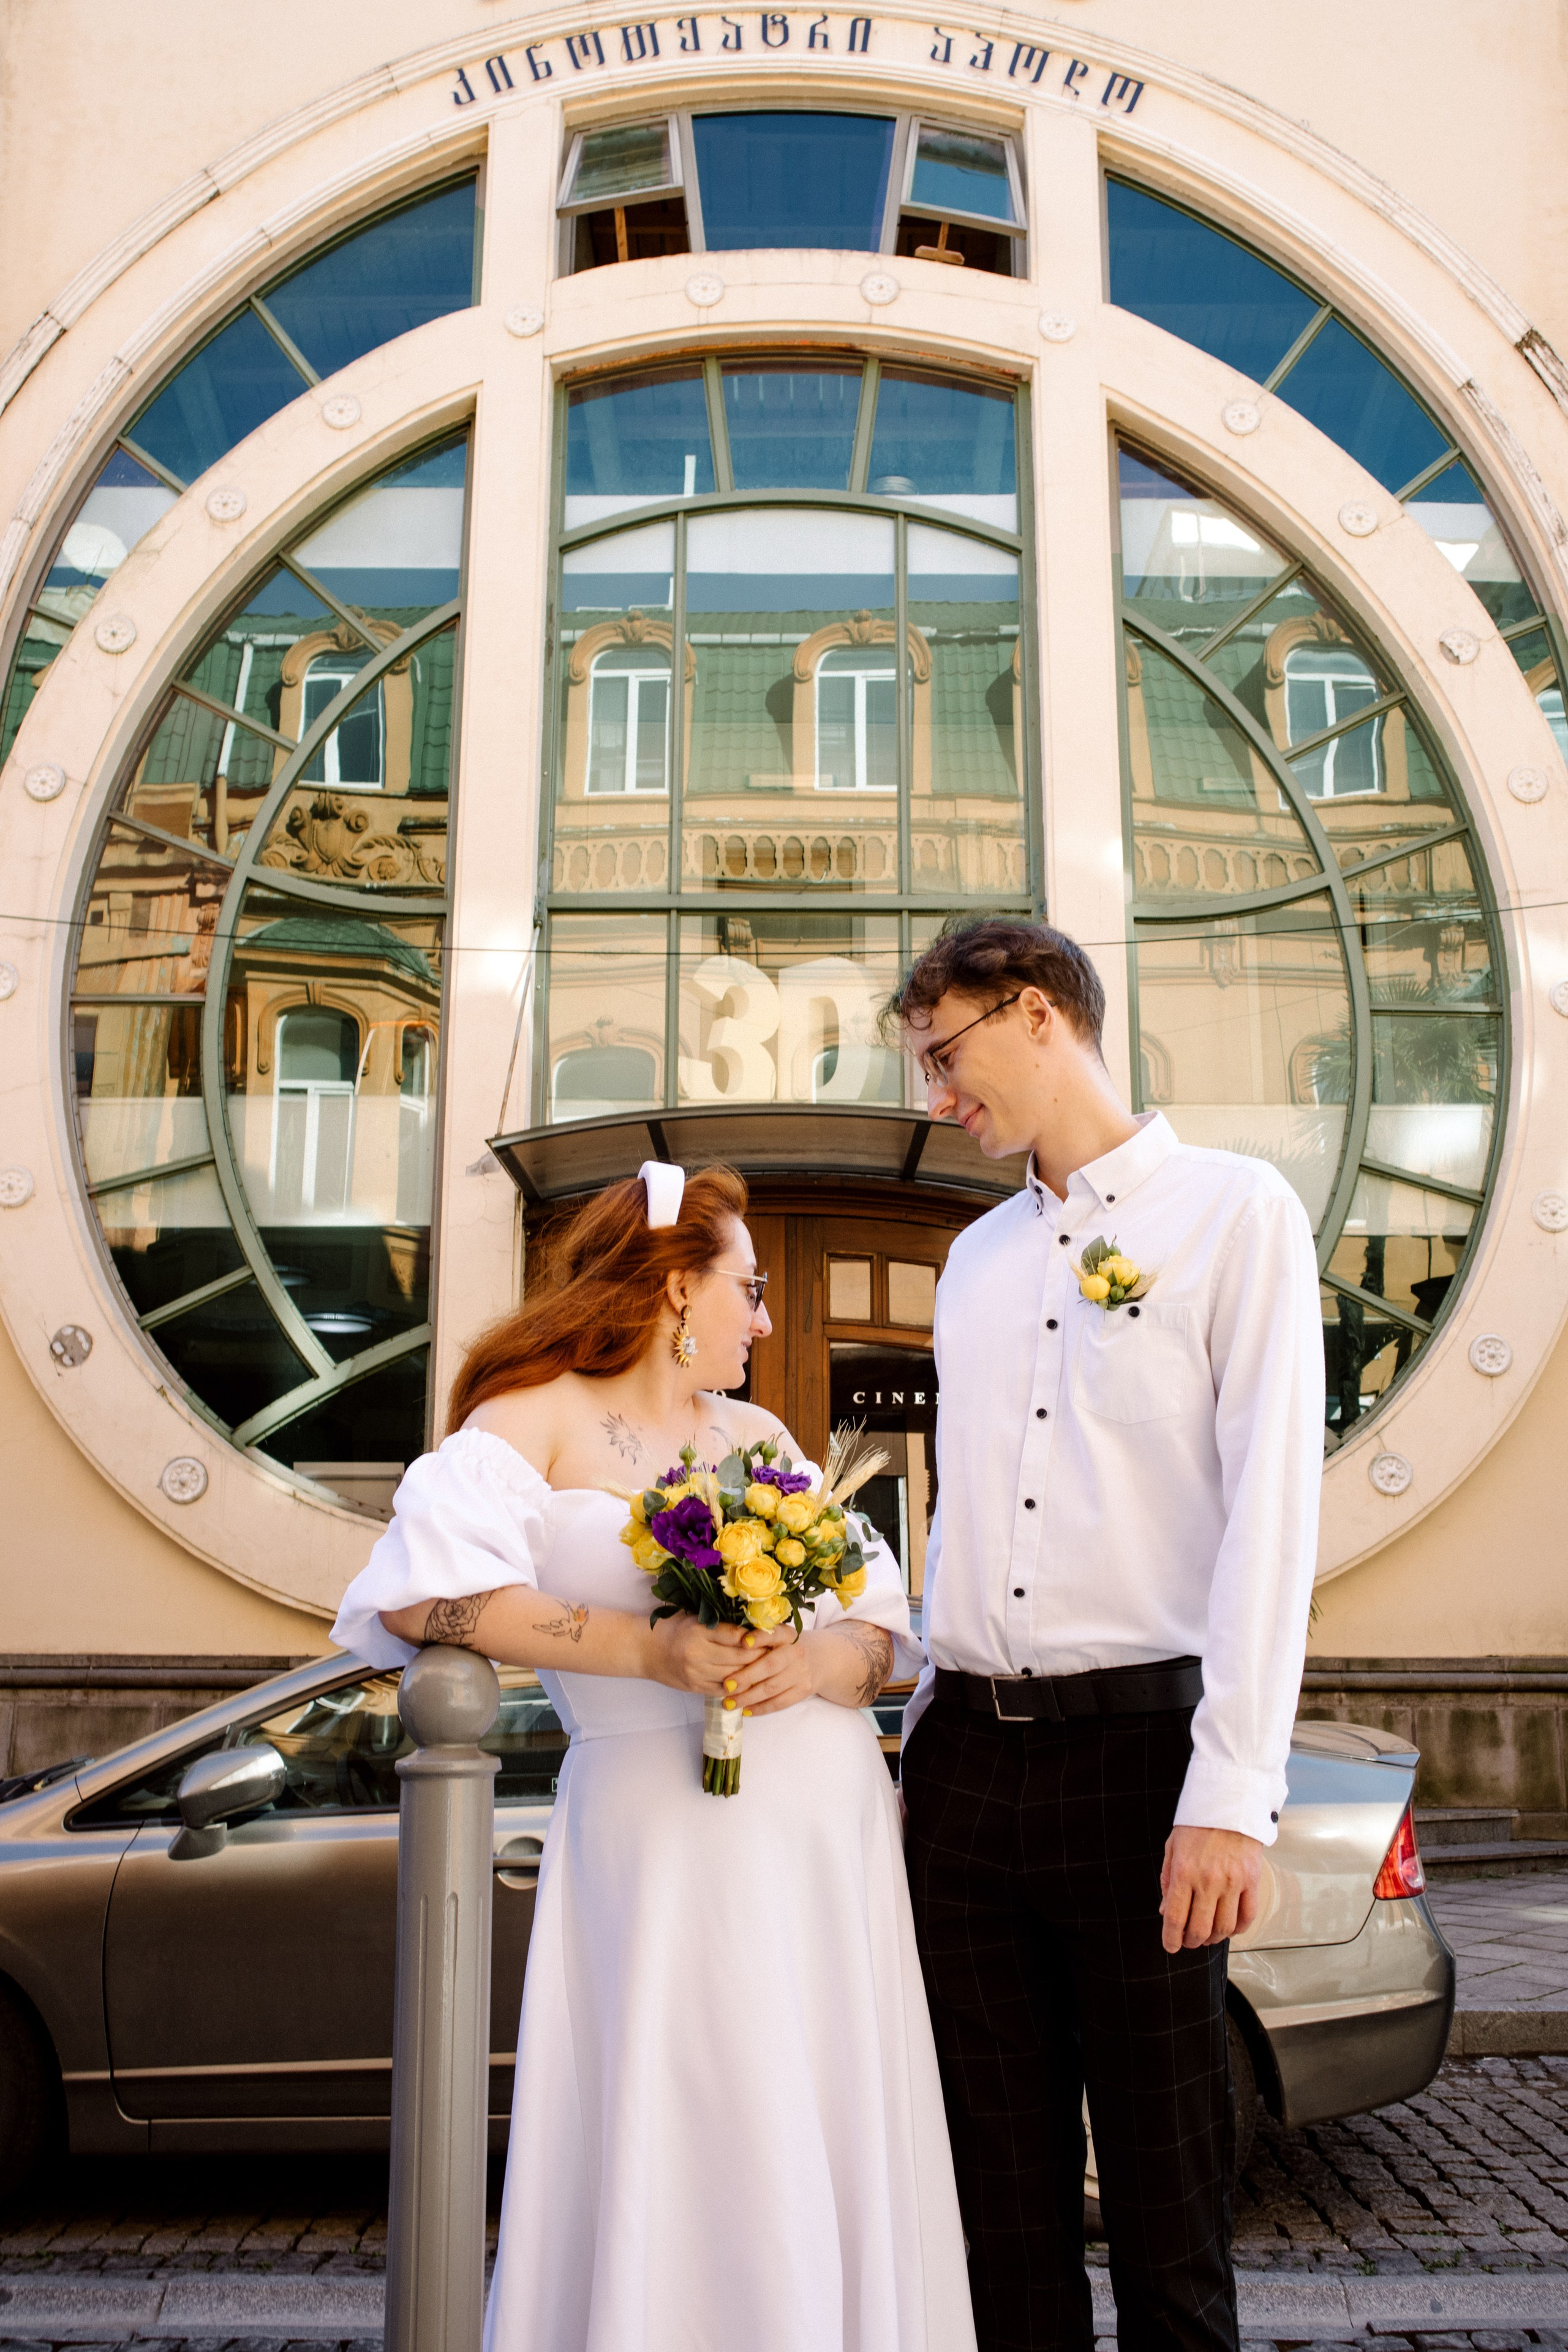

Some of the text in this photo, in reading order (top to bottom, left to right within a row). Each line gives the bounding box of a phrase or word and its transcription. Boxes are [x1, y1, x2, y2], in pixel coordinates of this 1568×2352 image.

[452, 13, 1145, 113] კინოთეატრი აპოლო
[679, 955, 885, 1103] 3D
